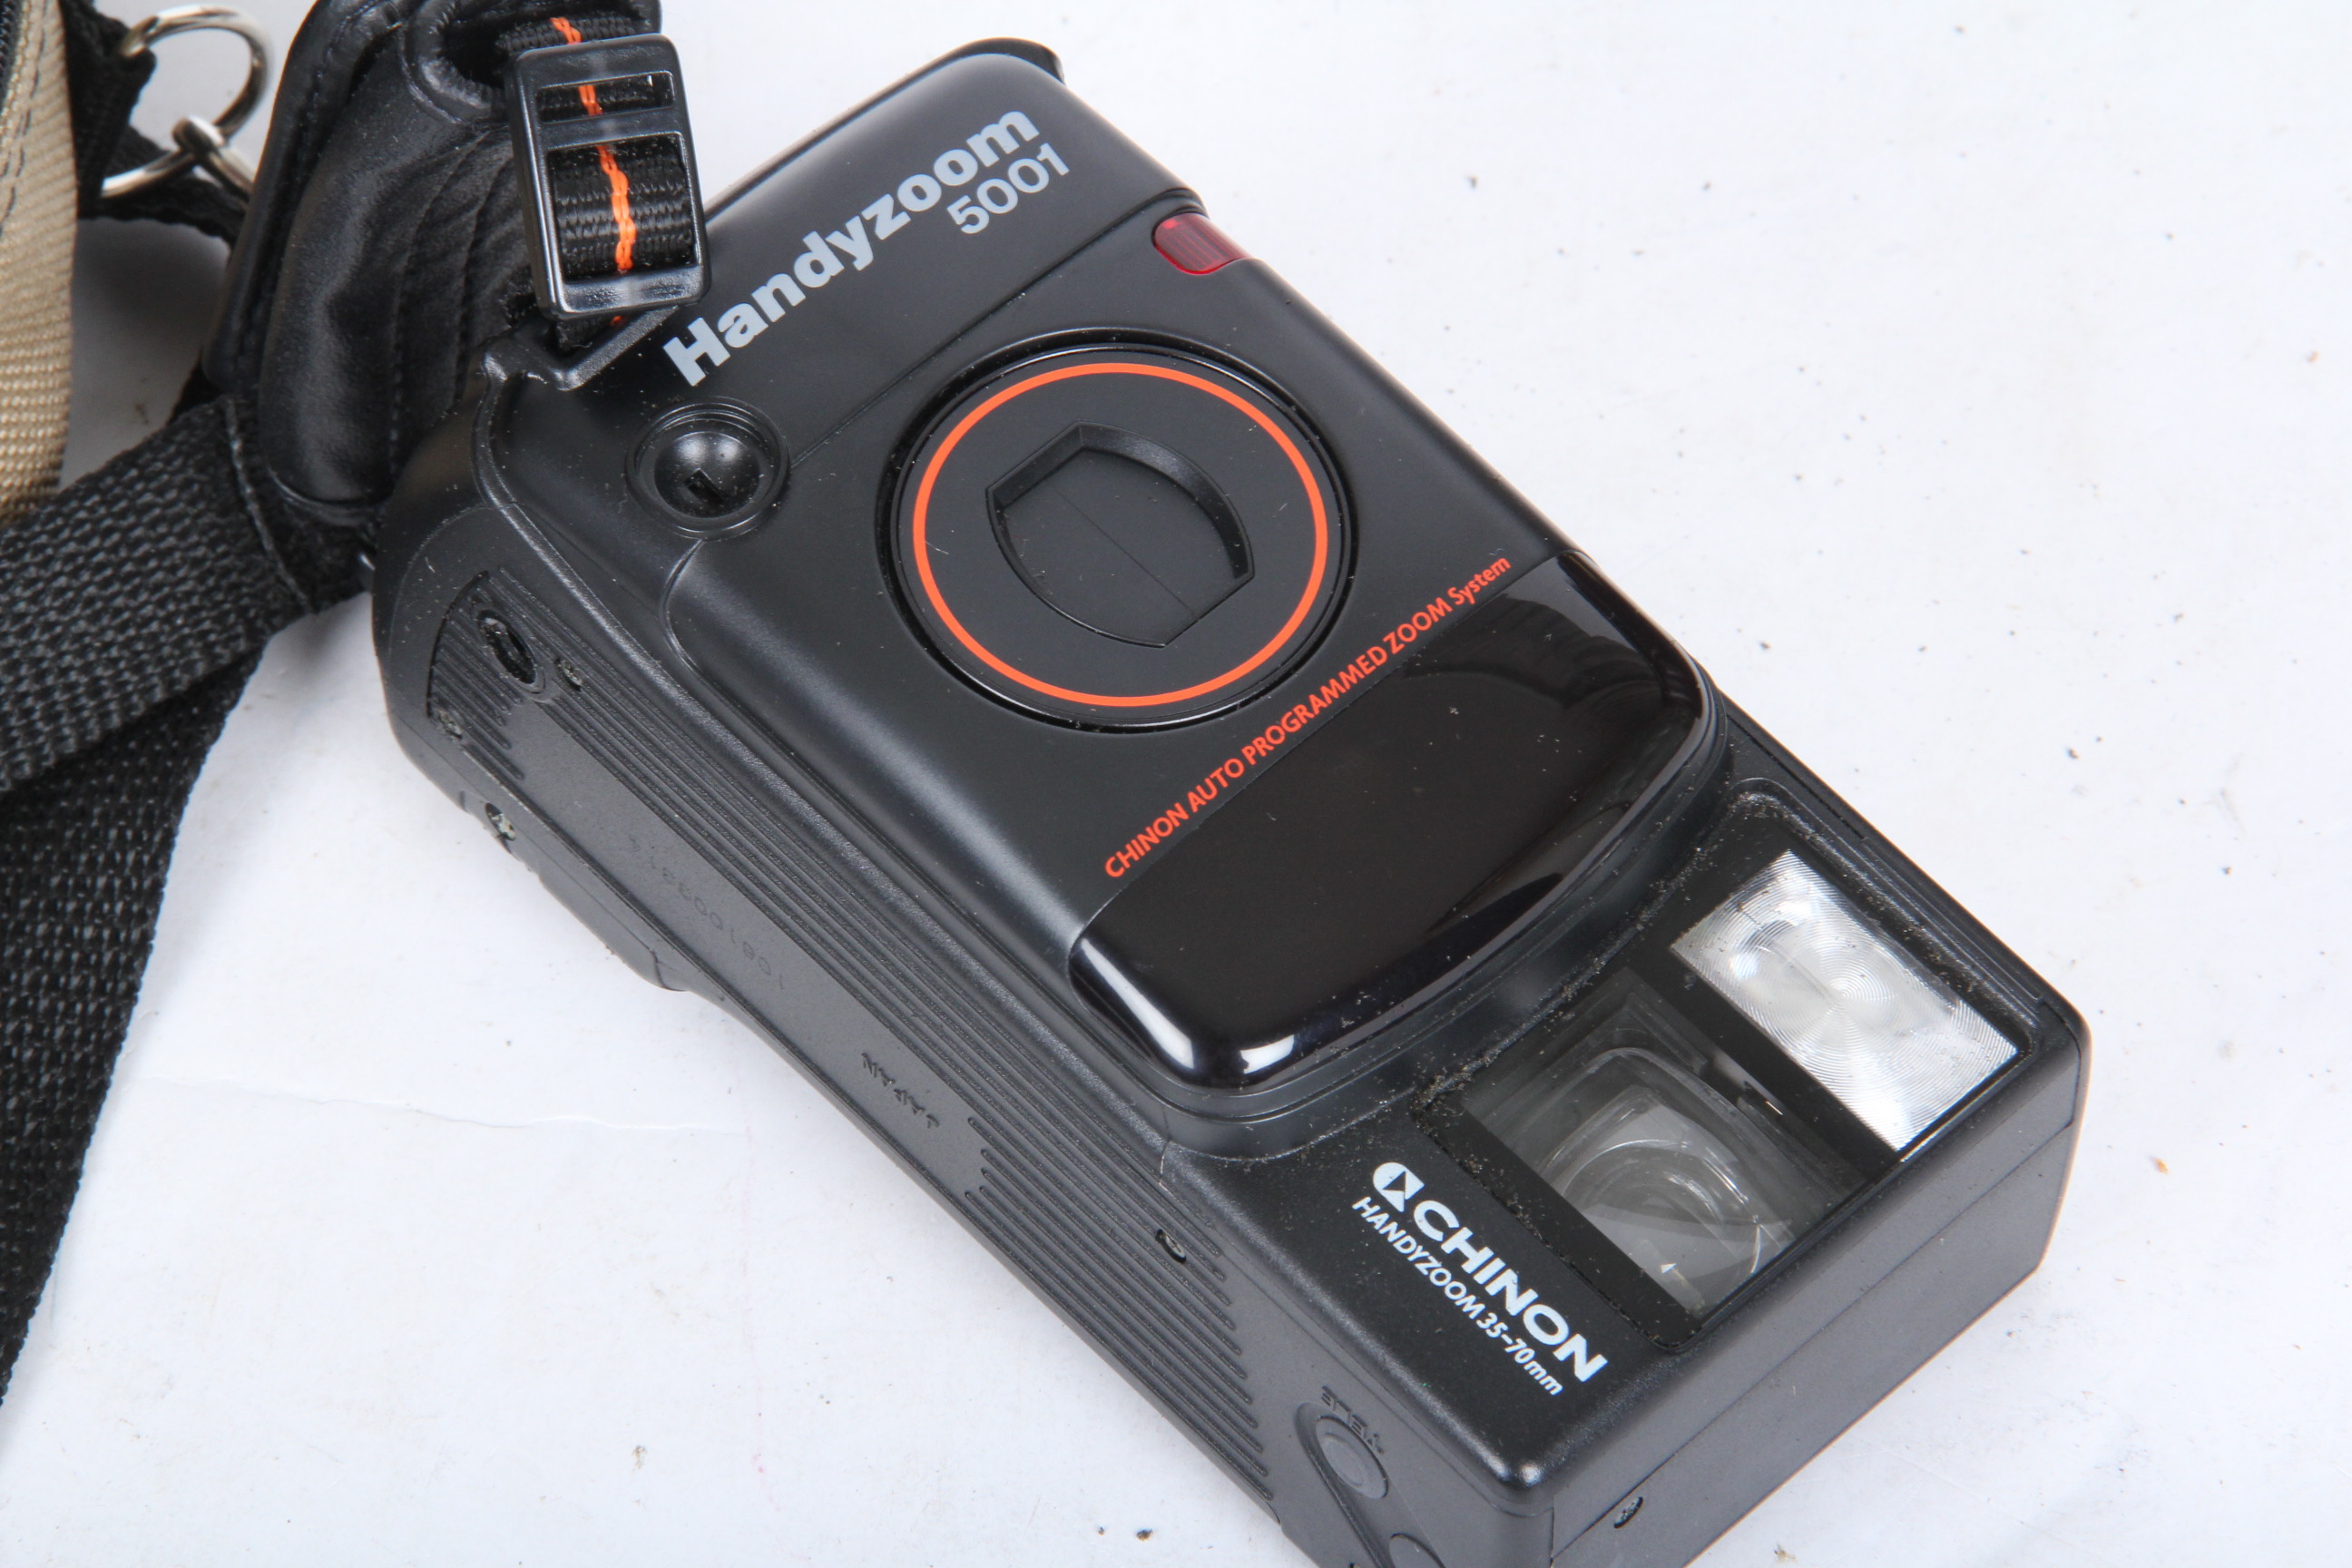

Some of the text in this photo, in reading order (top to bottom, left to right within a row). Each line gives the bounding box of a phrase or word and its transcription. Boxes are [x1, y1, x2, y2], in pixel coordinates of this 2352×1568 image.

[663, 111, 1040, 387] Handyzoom
[946, 142, 1070, 235] 5001
[1104, 557, 1512, 878] CHINON AUTO PROGRAMMED ZOOM System
[1351, 1196, 1563, 1396] HANDYZOOM 35-70mm
[1413, 1200, 1609, 1383] CHINON
